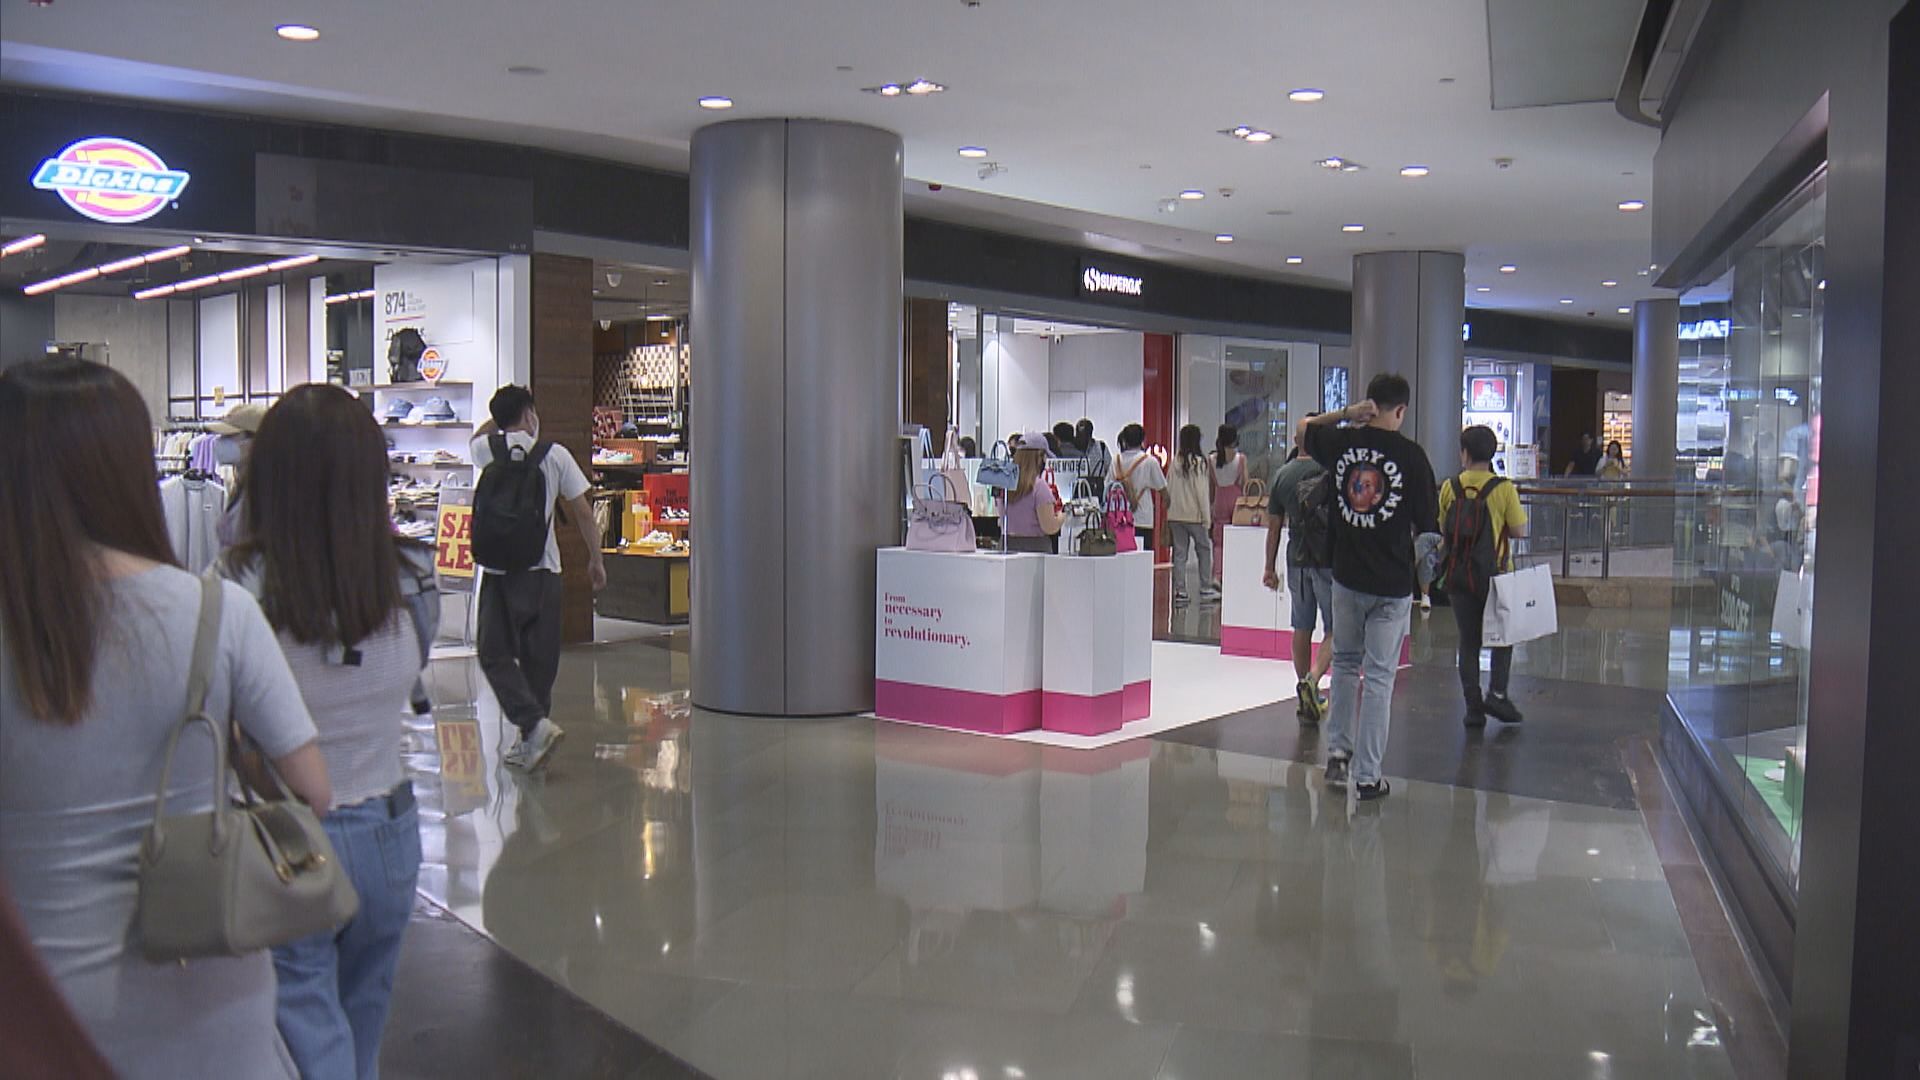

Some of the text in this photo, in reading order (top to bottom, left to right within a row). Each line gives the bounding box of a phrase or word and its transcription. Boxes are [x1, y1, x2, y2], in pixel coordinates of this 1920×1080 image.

[50, 164, 174, 194] Dickies
[385, 291, 406, 315] 874
[1384, 461, 1402, 488] ON
[1379, 492, 1402, 520] MY
[441, 512, 473, 538] SA
[437, 542, 473, 570] LE
[884, 592, 906, 603] From
[884, 604, 943, 622] necessary
[884, 616, 893, 625] to
[884, 626, 971, 649] revolutionary.
